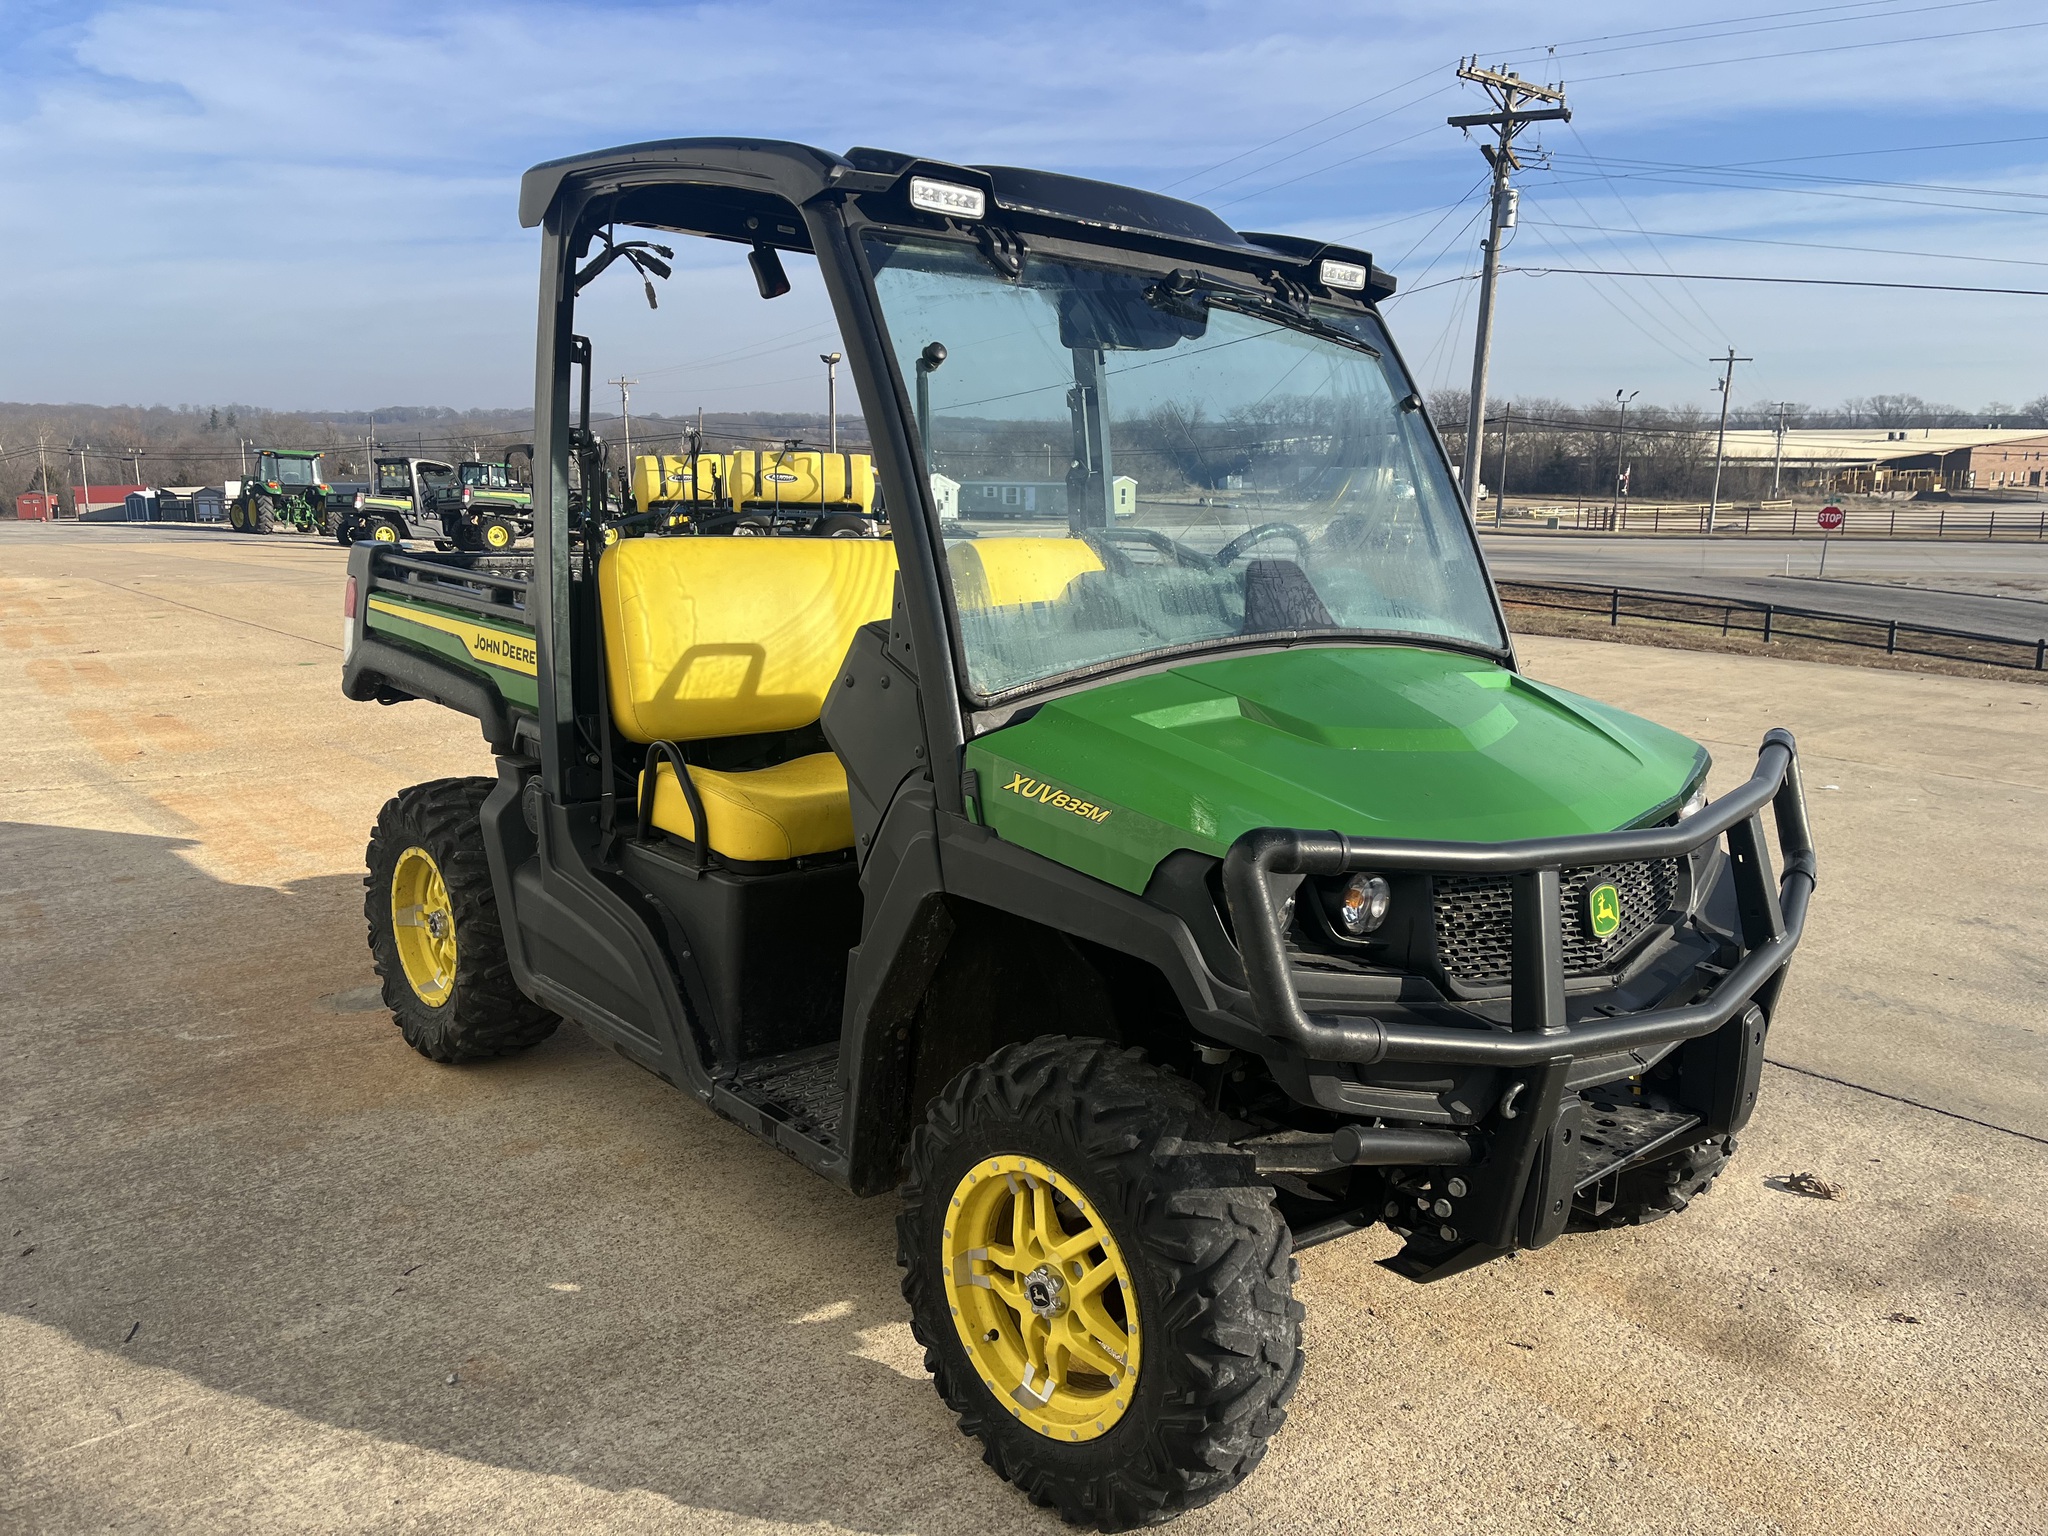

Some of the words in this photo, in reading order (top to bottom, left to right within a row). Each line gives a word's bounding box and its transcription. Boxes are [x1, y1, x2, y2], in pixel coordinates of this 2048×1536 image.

[1819, 513, 1842, 523] STOP
[474, 633, 500, 655] JOHN
[502, 640, 536, 665] DEERE
[1002, 773, 1111, 823] XUV835M
